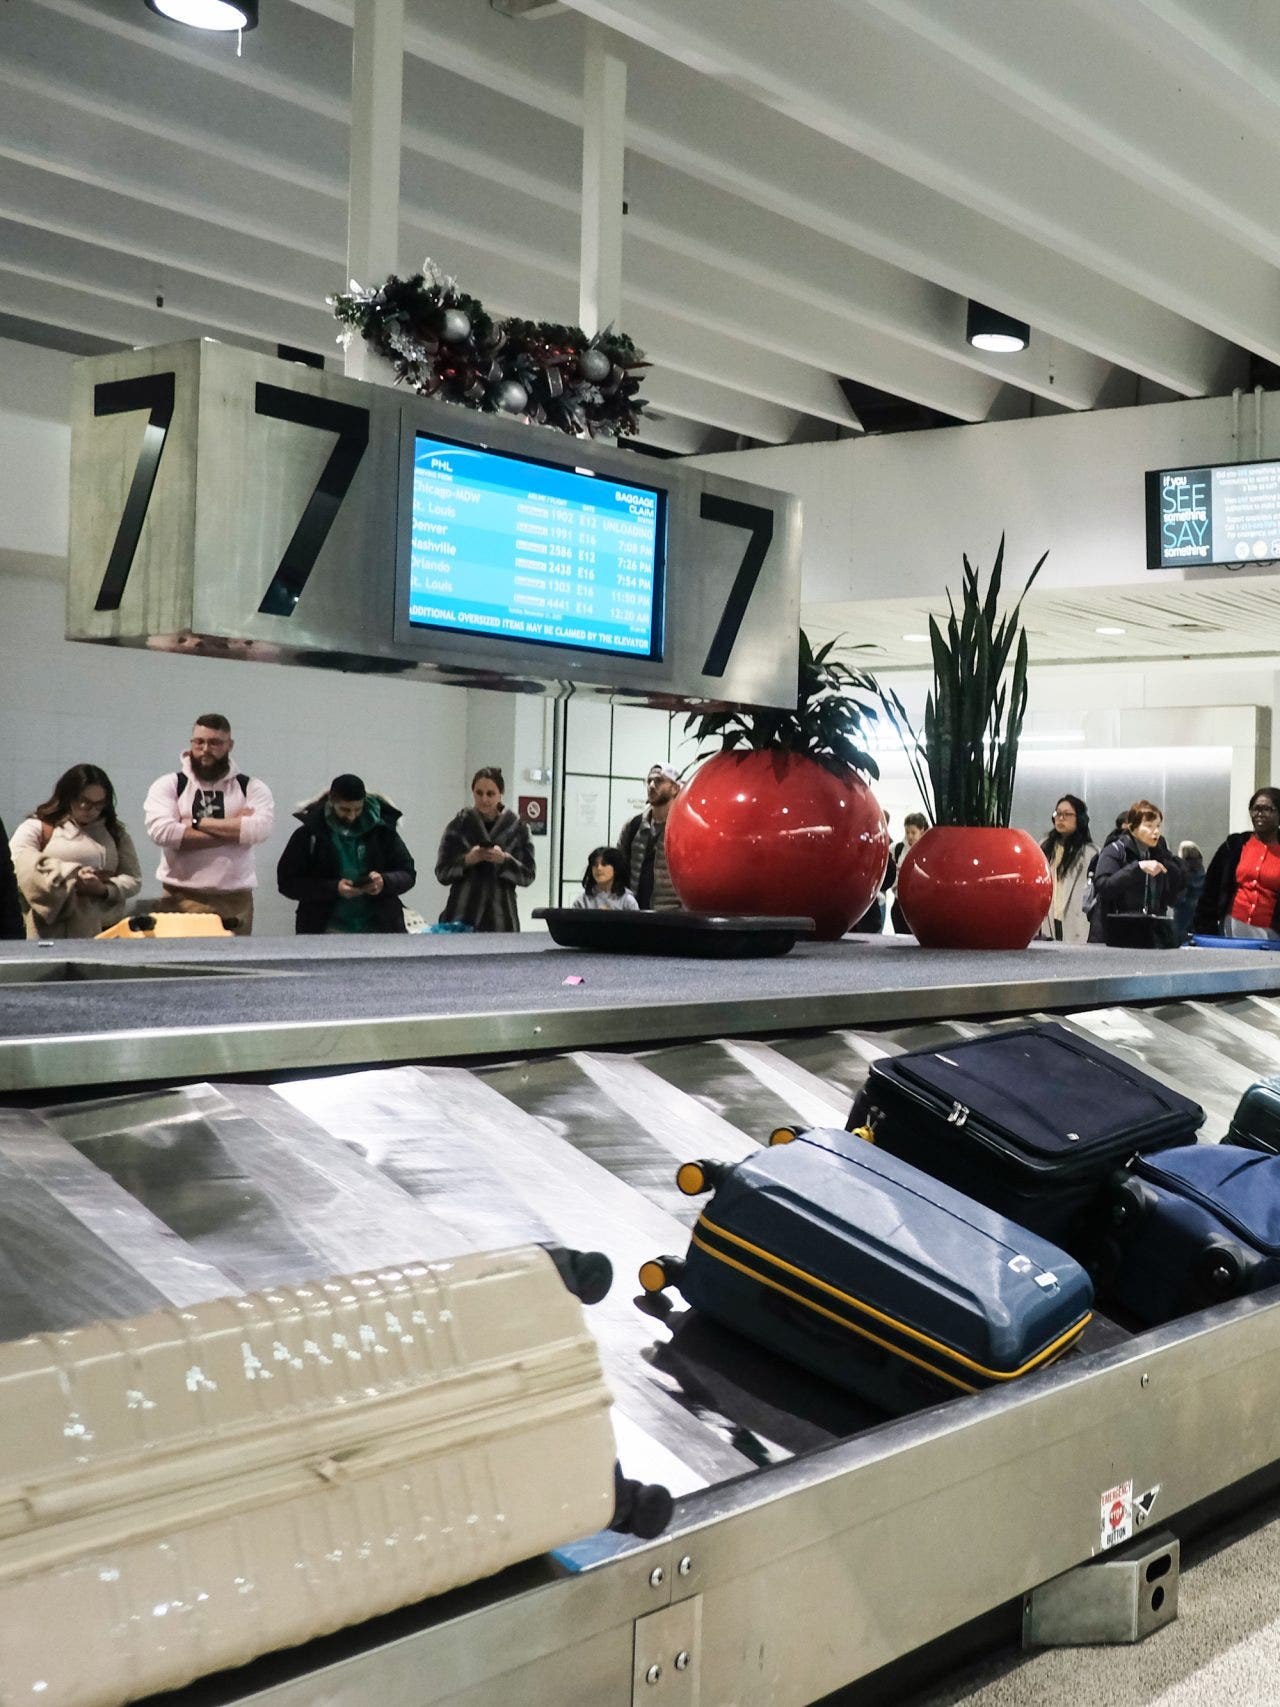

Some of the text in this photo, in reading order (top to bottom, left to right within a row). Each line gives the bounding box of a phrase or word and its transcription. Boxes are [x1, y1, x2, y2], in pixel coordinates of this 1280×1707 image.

[431, 458, 453, 473] PHL
[94, 371, 175, 611] 7
[1171, 476, 1187, 488] you
[254, 380, 371, 617] 7
[615, 491, 654, 508] BAGGAGE
[1163, 483, 1206, 513] SEE
[429, 501, 455, 518] Louis
[629, 504, 654, 517] CLAIM
[1163, 510, 1207, 522] something
[412, 516, 448, 535] Denver
[579, 512, 597, 529] E12
[603, 518, 653, 540] UNLOADING
[1163, 519, 1208, 548] SAY
[411, 537, 456, 556] Nashville
[578, 549, 596, 564] E12
[425, 575, 453, 593] Louis
[700, 491, 774, 677] 7
[458, 612, 501, 628] OVERSIZED
[502, 619, 525, 633] ITEMS
[526, 622, 543, 634] MAY
[544, 625, 554, 636] BE
[555, 627, 586, 640] CLAIMED
[587, 631, 597, 642] BY
[599, 632, 613, 644] THE
[613, 633, 650, 648] ELEVATOR
[1101, 1481, 1131, 1505] EMERGENCY
[1106, 1526, 1126, 1545] BUTTON
